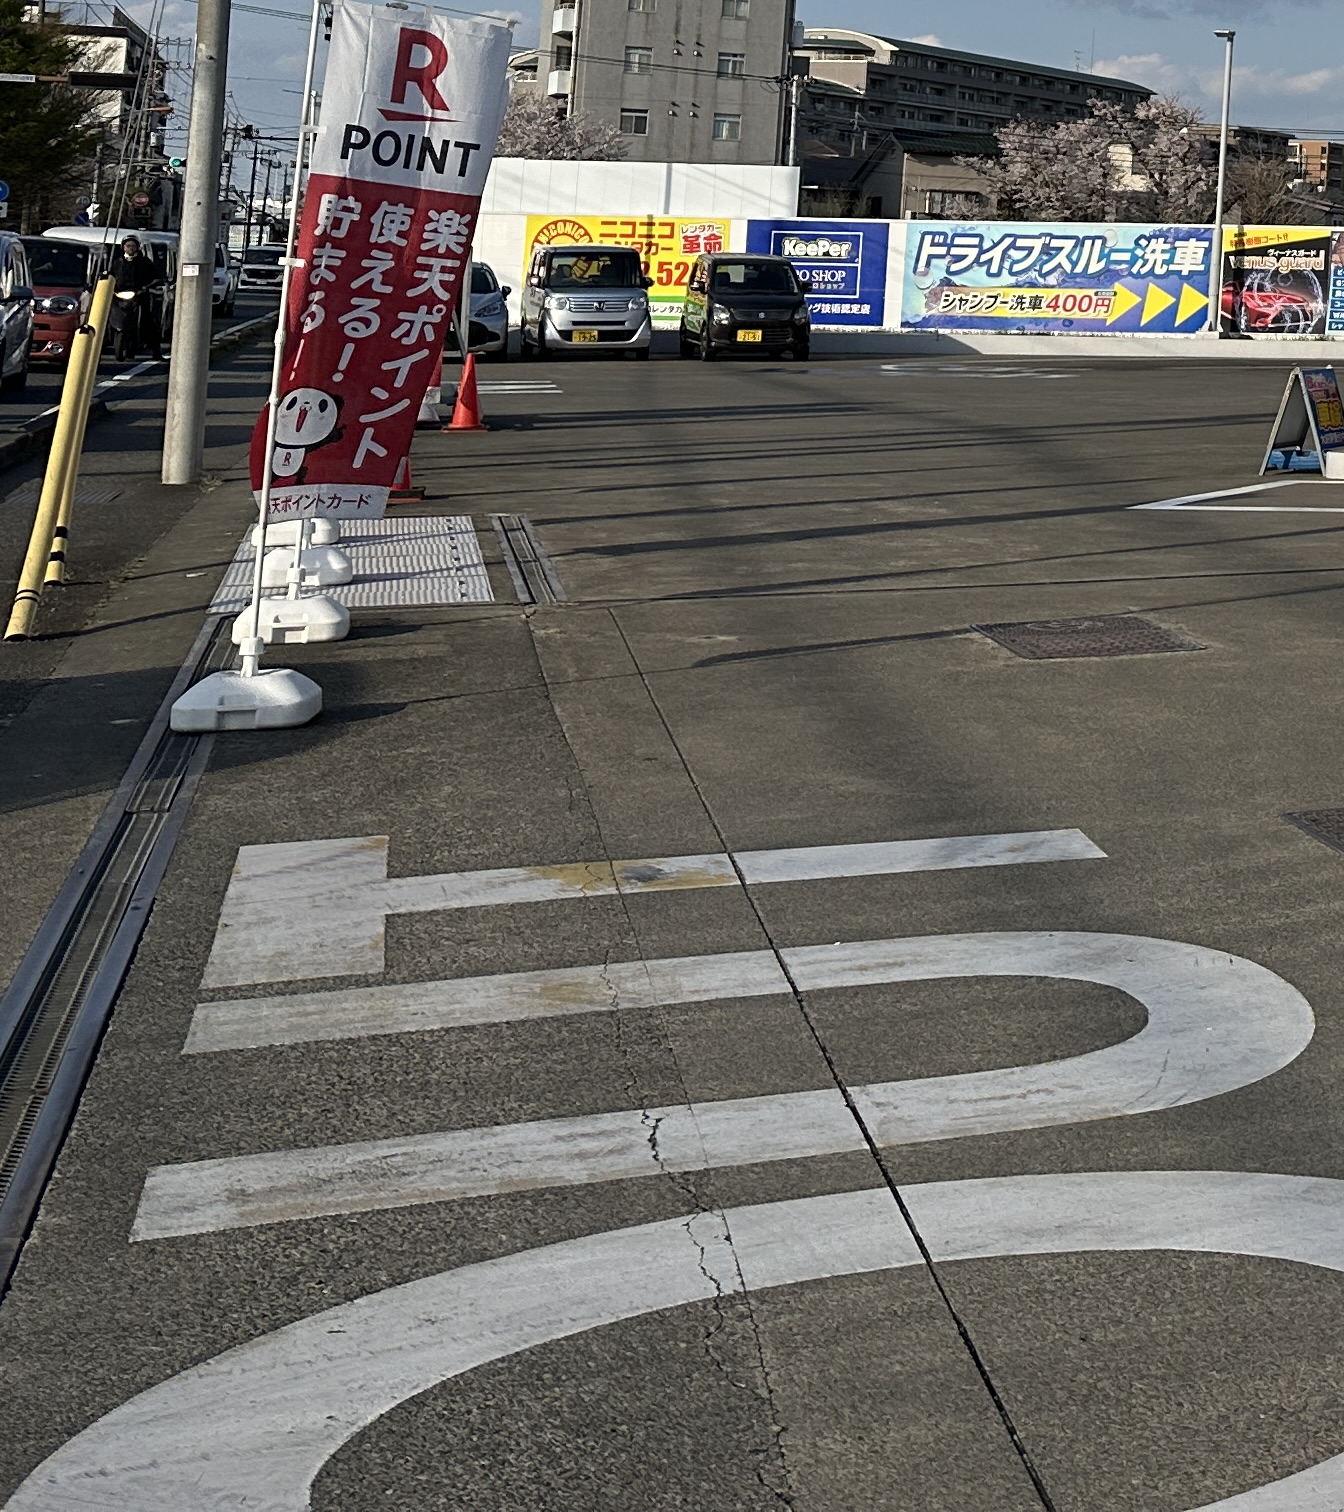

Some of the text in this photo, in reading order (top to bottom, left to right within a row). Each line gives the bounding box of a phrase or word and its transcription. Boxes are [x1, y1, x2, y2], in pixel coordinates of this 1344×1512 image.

[390, 27, 450, 111] R
[340, 124, 480, 177] POINT
[599, 220, 675, 239] ニコニコ
[682, 233, 722, 254] 革命
[782, 237, 852, 258] KeePer
[917, 232, 1208, 276] ドライブスルー洗車
[811, 269, 847, 282] SHOP
[352, 209, 472, 469] 楽天ポイント
